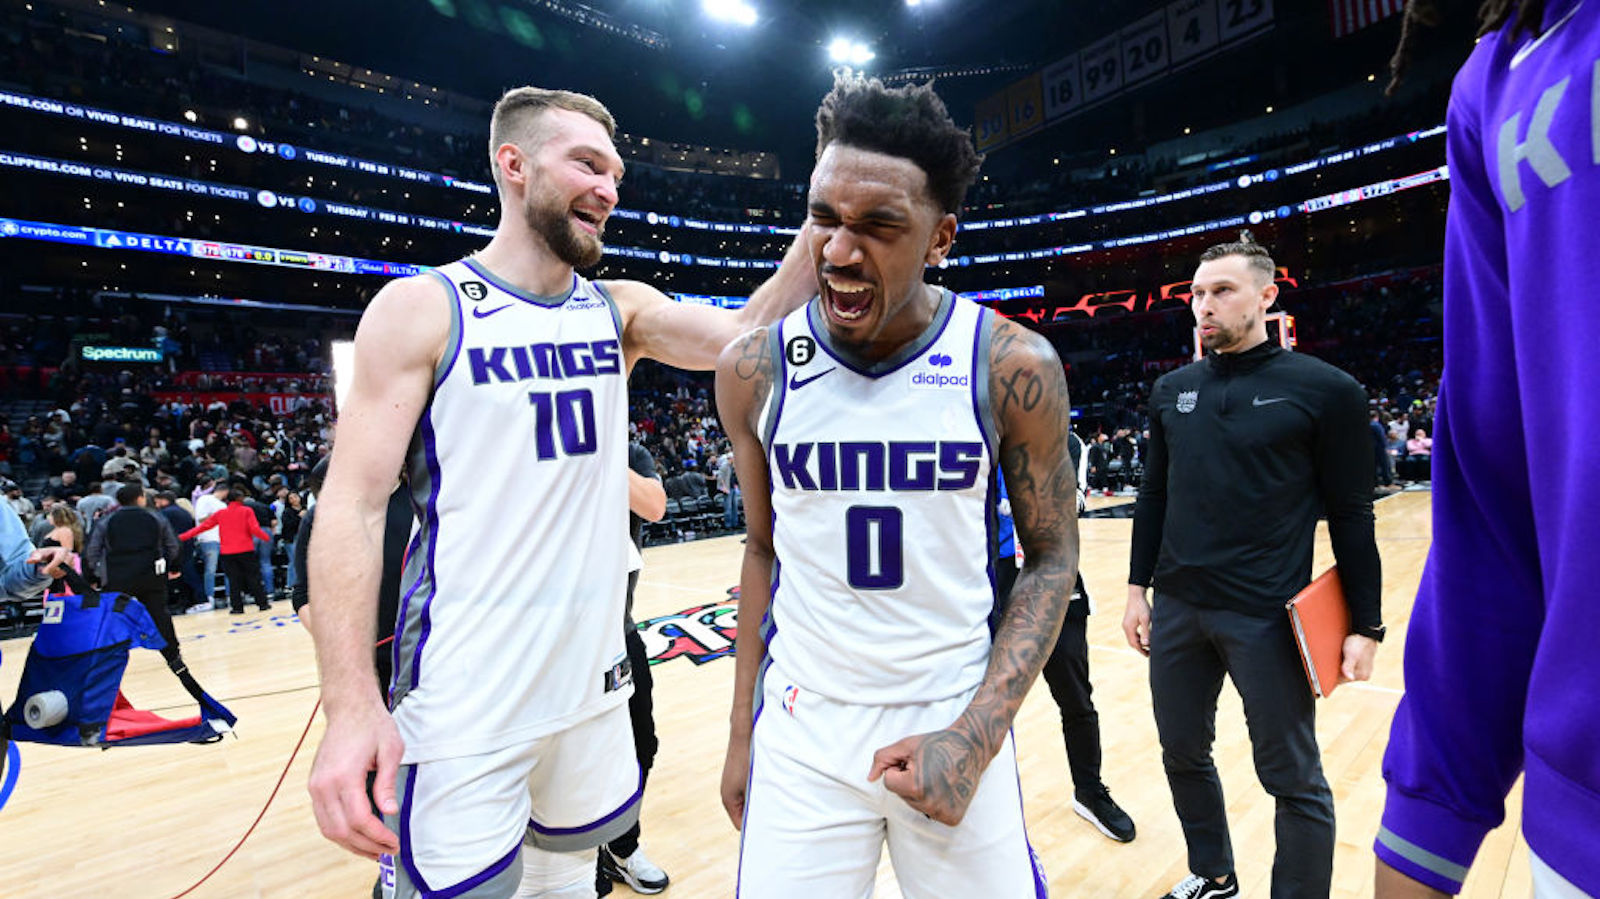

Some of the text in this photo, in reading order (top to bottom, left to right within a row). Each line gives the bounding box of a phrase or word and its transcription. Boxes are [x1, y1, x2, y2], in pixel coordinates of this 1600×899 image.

[1184, 17, 1201, 44] 4
[1129, 36, 1161, 71] 20
[1086, 58, 1116, 90] 99
[1050, 80, 1073, 107] 18
[65, 105, 85, 118] OR
[86, 109, 120, 125] VIVID
[121, 116, 157, 132] SEATS
[158, 123, 181, 136] FOR
[183, 128, 224, 144] TICKETS
[257, 142, 275, 155] VS
[305, 151, 348, 168] TUESDAY
[358, 161, 377, 174] FEB
[0, 154, 250, 201] CLIPPERS.COM OR VIVID SEATS FOR TICKETS
[1251, 174, 1264, 183] VS
[277, 197, 296, 208] VS
[325, 203, 368, 219] TUESDAY
[379, 212, 396, 224] FEB
[1263, 210, 1276, 219] VS
[20, 225, 87, 241] crypto.com
[126, 235, 187, 252] DELTA
[389, 265, 418, 276] ULTRA
[468, 284, 483, 299] 6
[1013, 286, 1042, 297] DELTA
[82, 346, 157, 361] Spectrum
[791, 339, 809, 363] 6
[467, 339, 621, 386] KINGS
[912, 372, 968, 388] dialpad
[528, 388, 598, 462] 10
[773, 441, 983, 491] KINGS
[845, 505, 904, 591] 0
